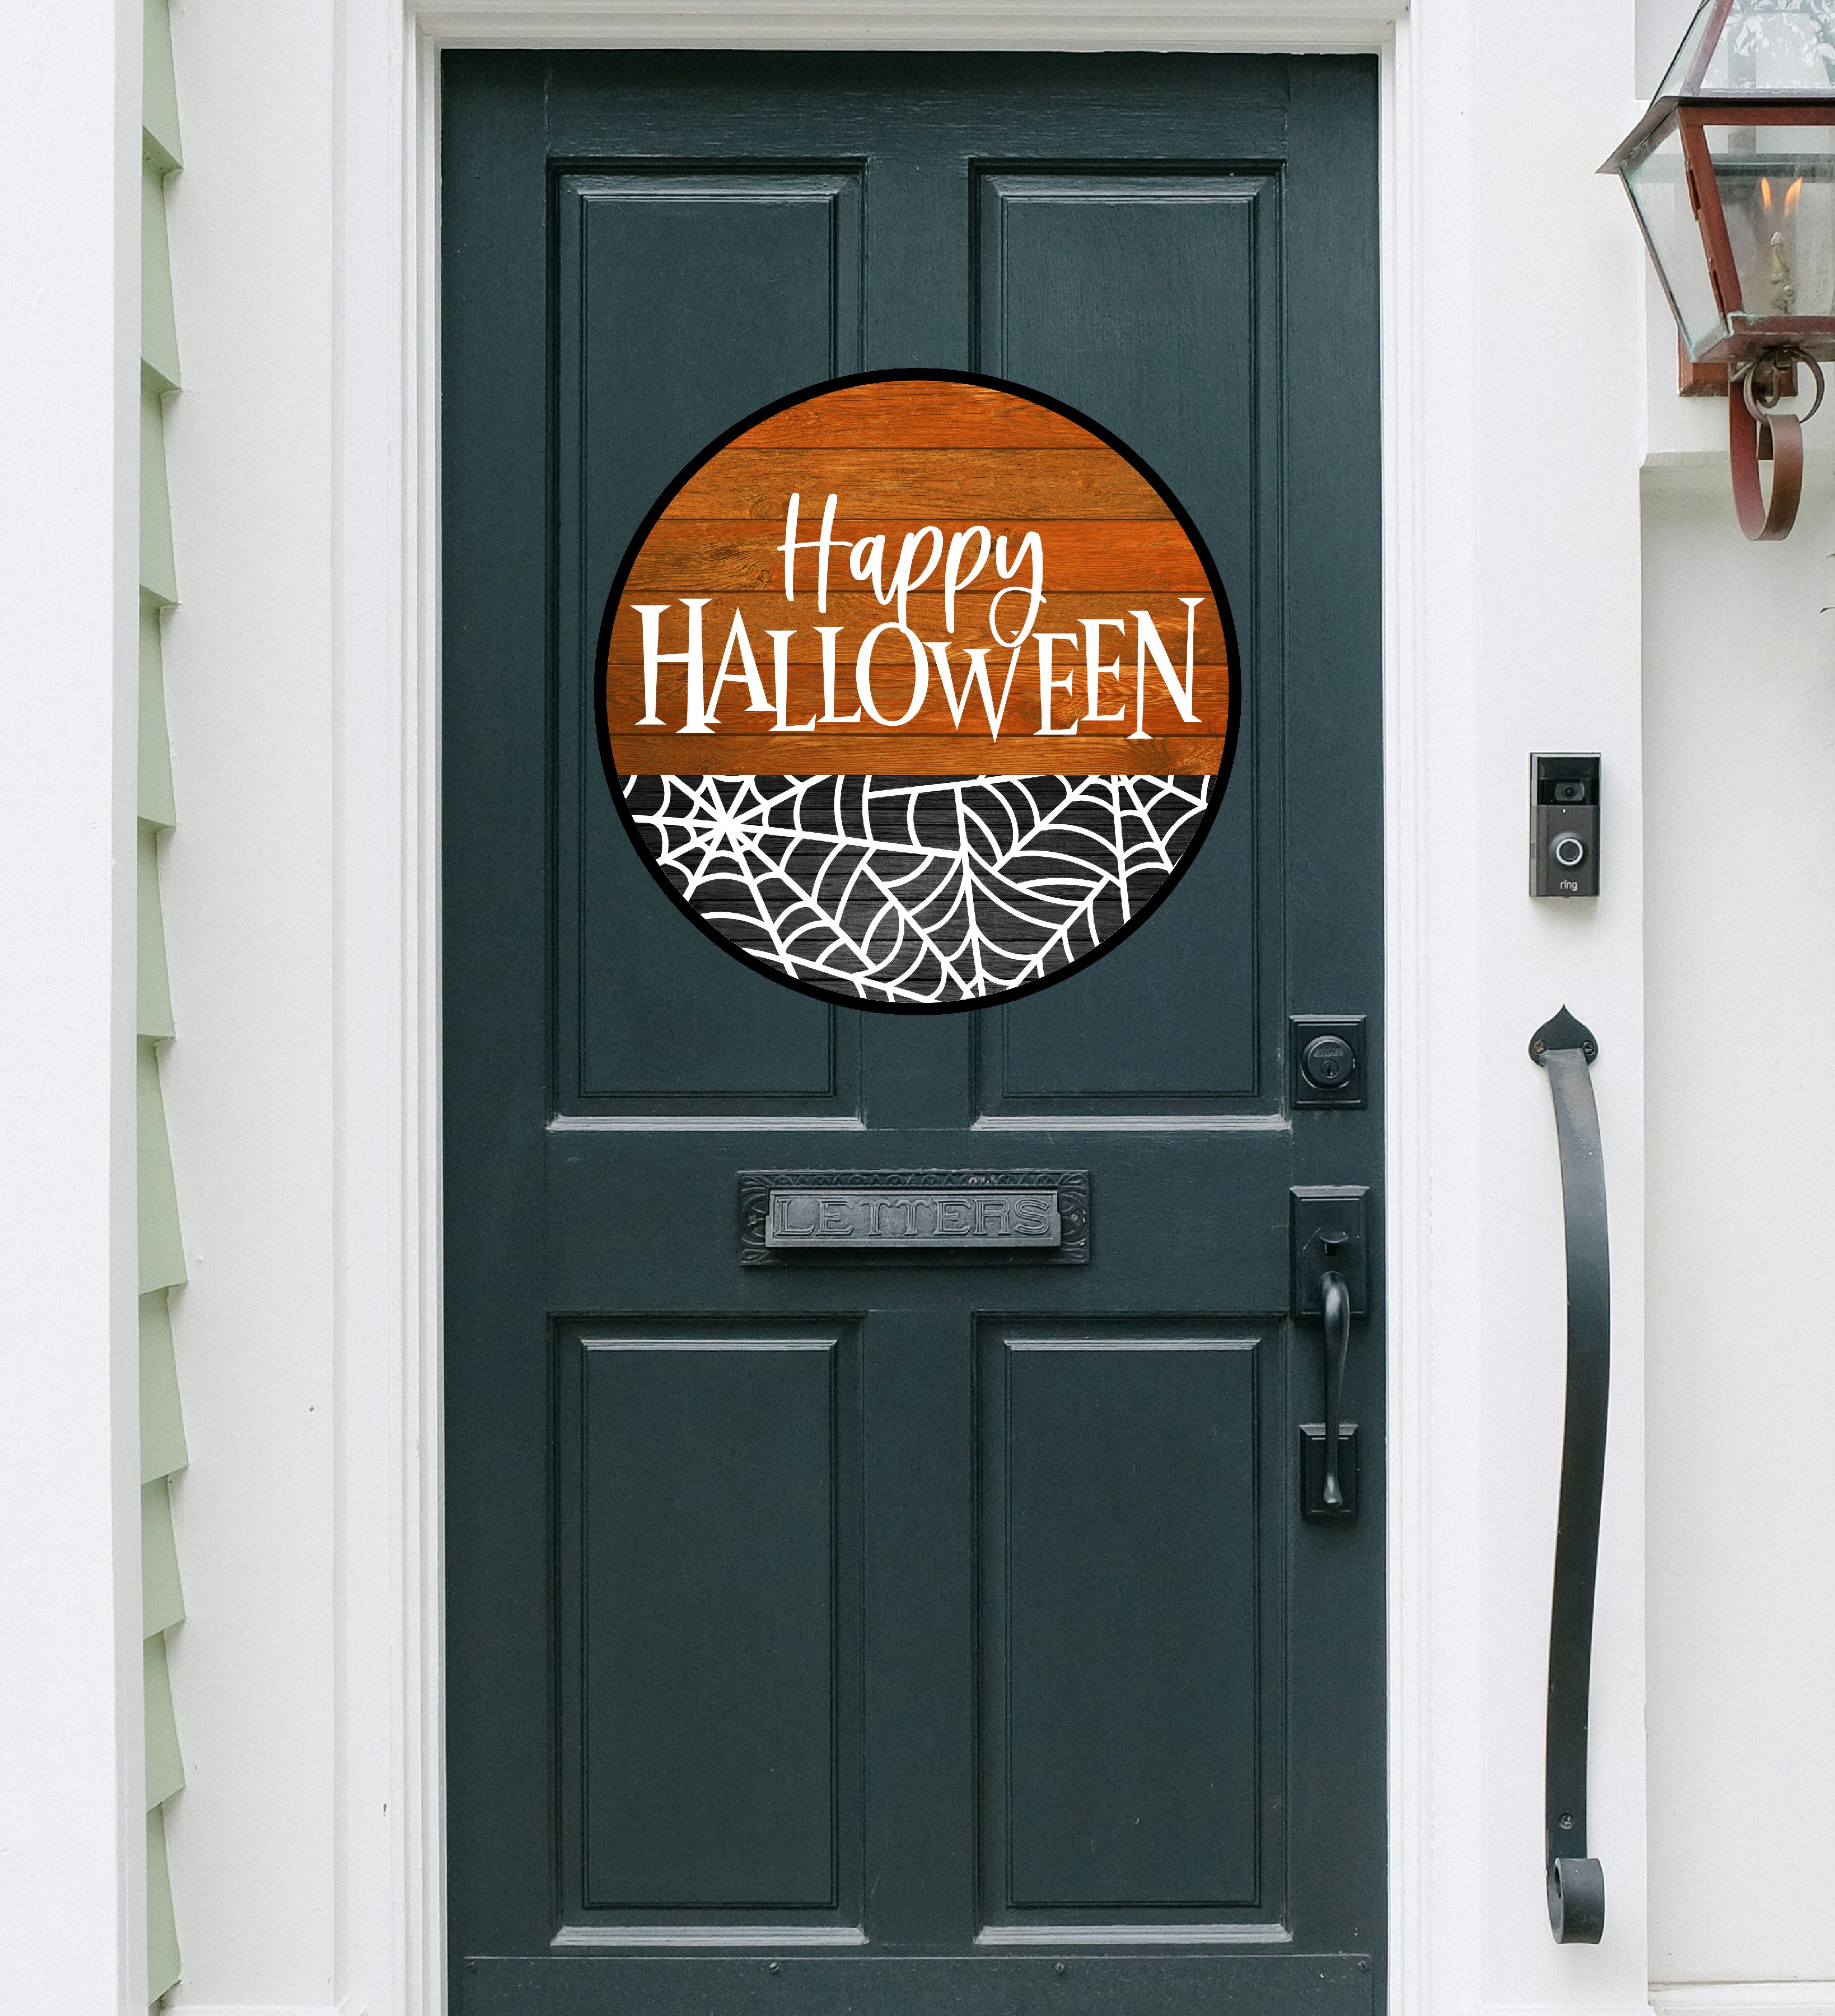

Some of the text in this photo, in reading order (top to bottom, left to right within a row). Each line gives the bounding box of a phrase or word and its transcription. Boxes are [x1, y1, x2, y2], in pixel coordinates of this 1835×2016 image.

[777, 492, 1046, 648] Happy
[631, 598, 1205, 743] HALLOWEEN
[1560, 879, 1577, 892] ring
[777, 1198, 1051, 1236] LETTERS
